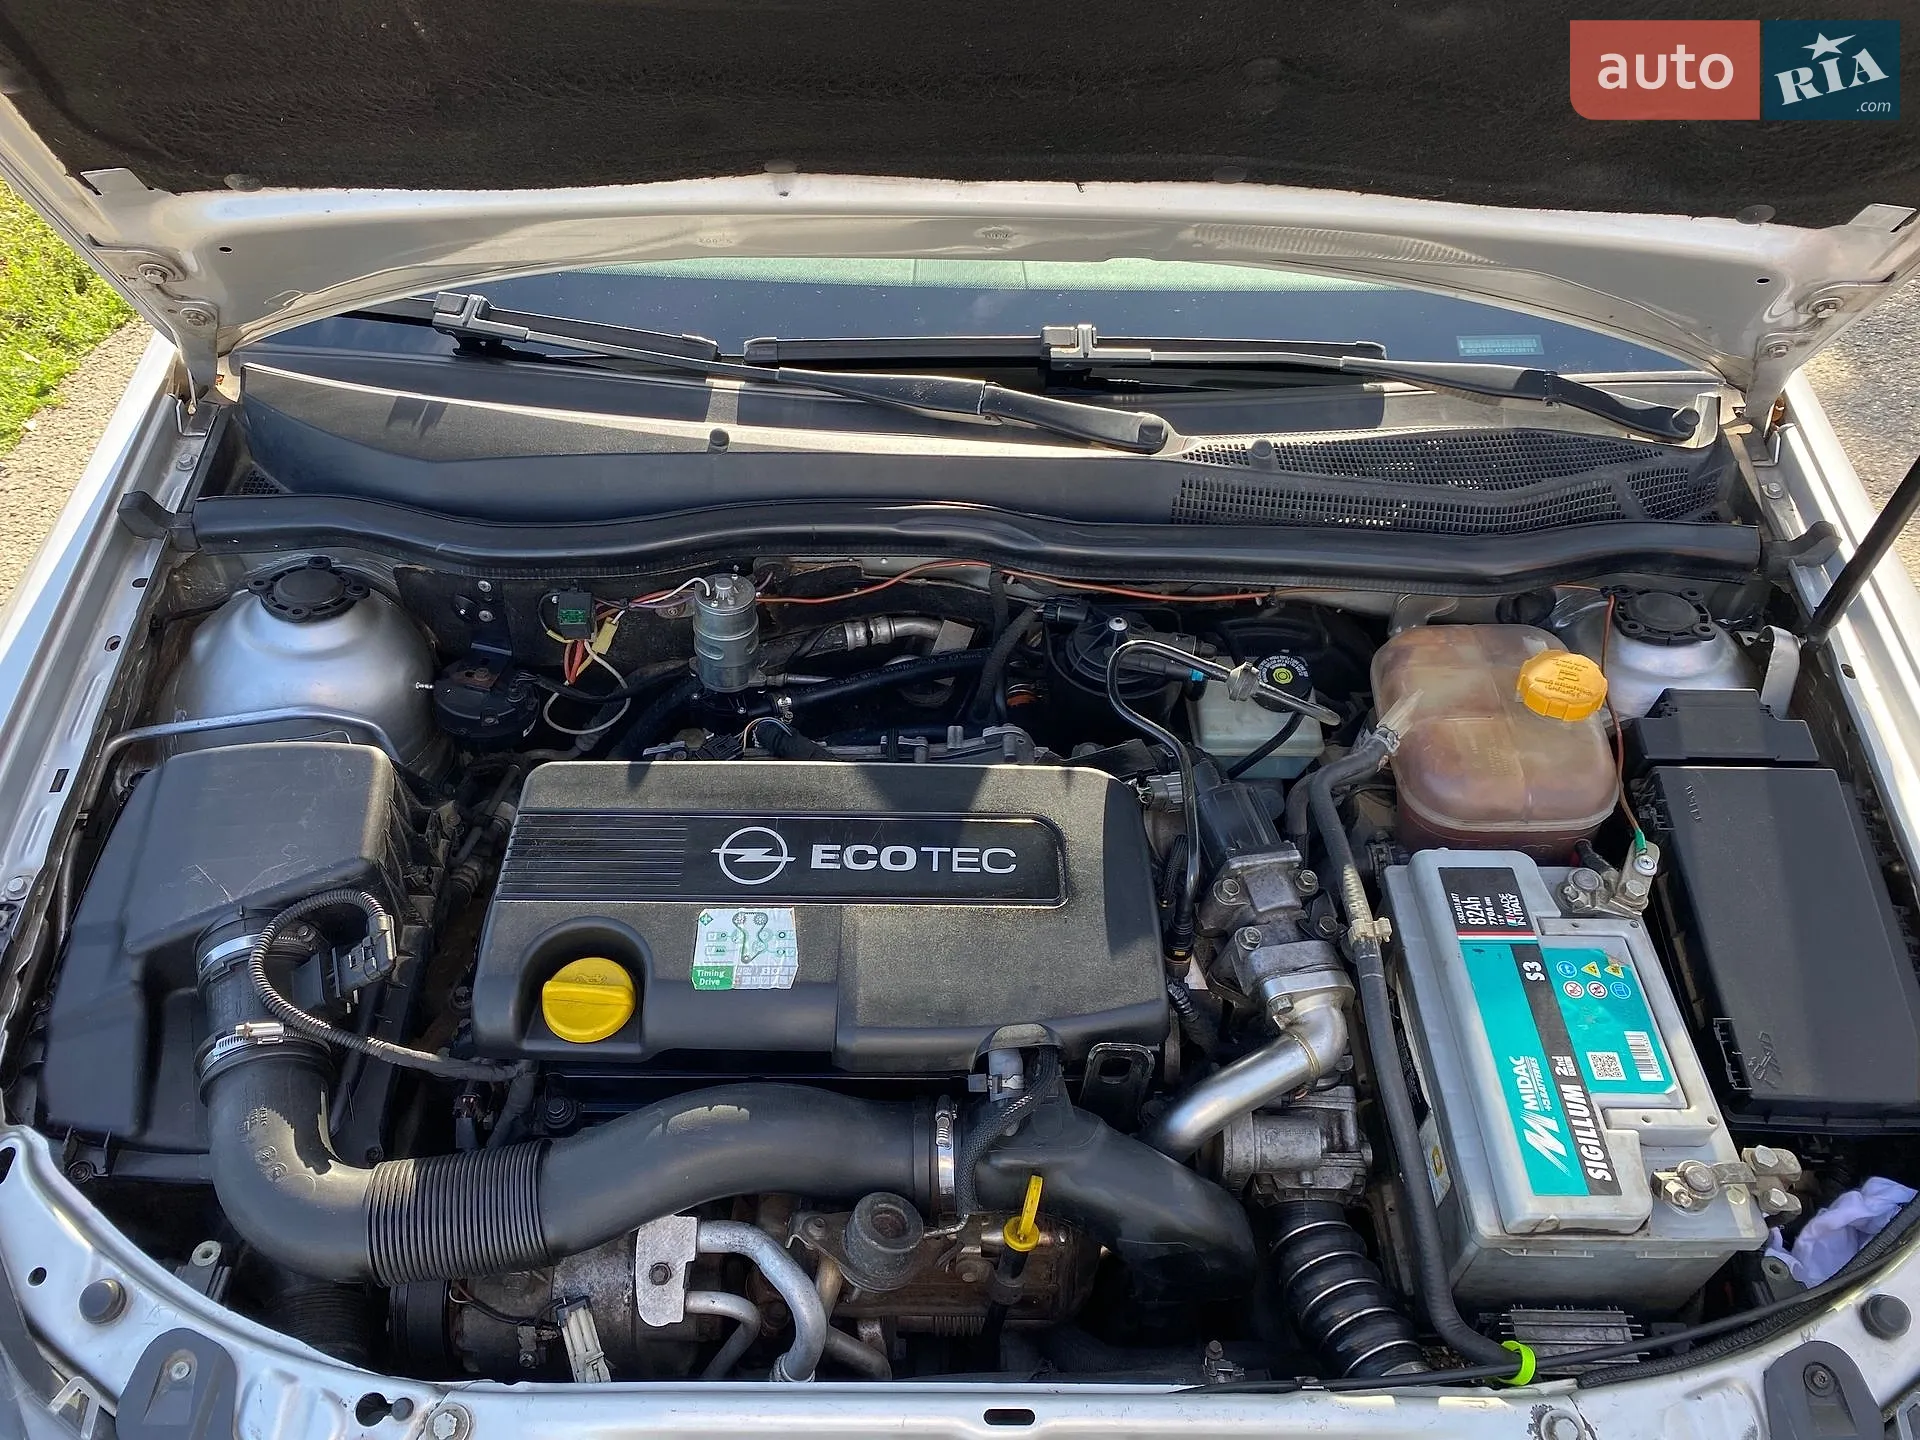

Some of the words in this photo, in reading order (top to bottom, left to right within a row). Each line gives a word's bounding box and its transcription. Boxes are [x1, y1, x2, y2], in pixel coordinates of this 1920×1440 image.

[811, 844, 1017, 874] ECOTEC
[1461, 896, 1487, 925] 82Ah
[1499, 893, 1515, 917] MADE
[1507, 893, 1524, 916] ITALY
[696, 969, 725, 978] Timing
[699, 978, 721, 986] Drive
[1522, 961, 1546, 981] S3
[1551, 1055, 1569, 1077] 2nd
[1508, 1055, 1540, 1111] MIDAC
[1559, 1083, 1612, 1181] SIGILLUM
